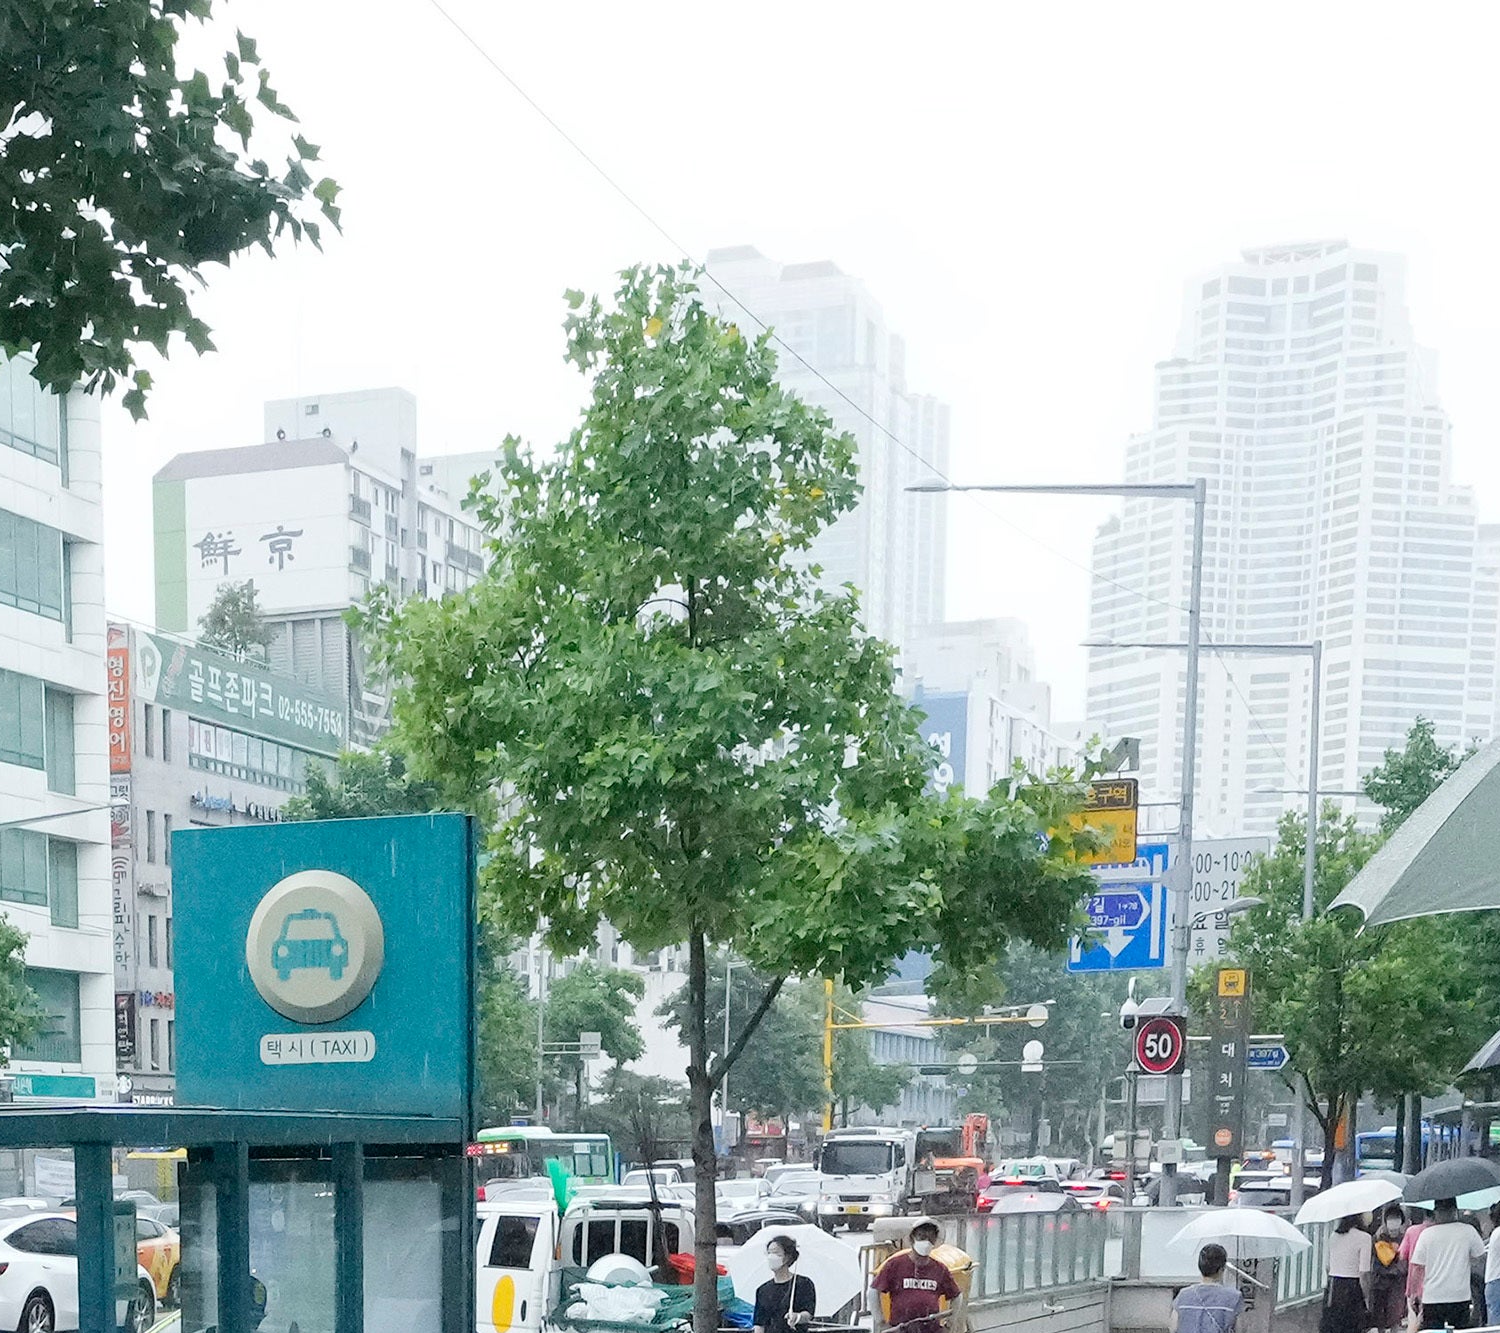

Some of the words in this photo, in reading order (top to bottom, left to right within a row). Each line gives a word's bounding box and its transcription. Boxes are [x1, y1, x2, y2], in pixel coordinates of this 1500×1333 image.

[188, 659, 274, 719] 골프존파크
[267, 1040, 303, 1058] 택시
[1144, 1033, 1172, 1059] 50
[1219, 1042, 1235, 1088] 대치
